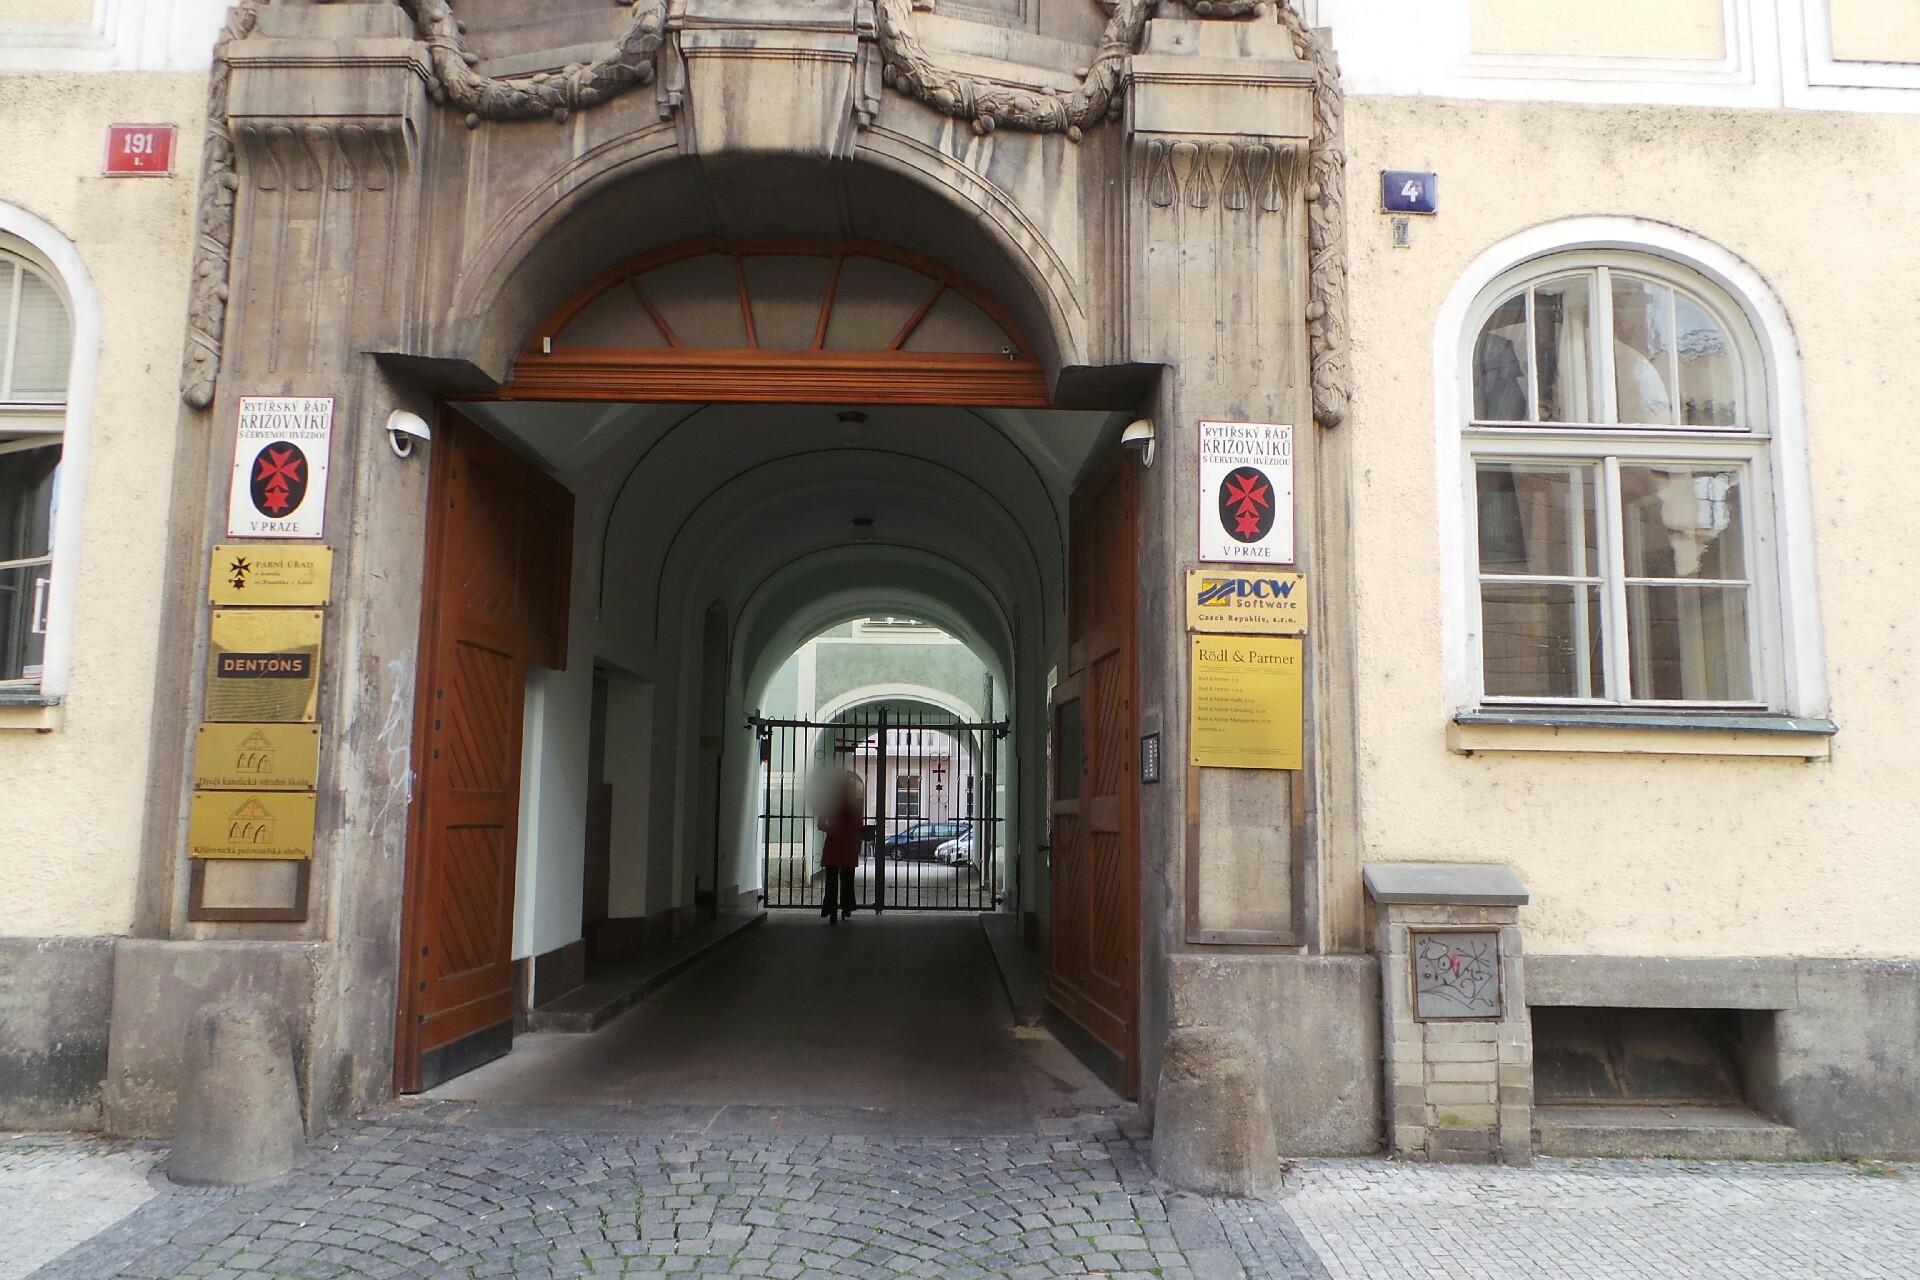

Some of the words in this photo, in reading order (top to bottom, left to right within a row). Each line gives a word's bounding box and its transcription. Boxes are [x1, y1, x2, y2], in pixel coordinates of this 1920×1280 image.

[124, 133, 153, 154] 191
[1401, 180, 1418, 202] 4
[304, 401, 328, 412] ŘÁD
[240, 411, 329, 430] KŘIŽOVNÍKŮ
[1205, 426, 1259, 439] RYTÍŘSKÝ
[1265, 427, 1288, 440] ŘÁD
[1203, 438, 1291, 457] KŘIŽOVNÍKŮ
[1203, 455, 1208, 464] S
[1210, 453, 1252, 465] ČERVENOU
[1253, 455, 1291, 466] HVĚZDOU
[250, 521, 258, 531] V
[261, 521, 300, 532] PRAZE
[1223, 546, 1231, 556] V
[1234, 546, 1271, 557] PRAZE
[1236, 579, 1296, 599] DCW
[1236, 599, 1297, 609] Software
[1199, 648, 1228, 662] Rödl
[1232, 650, 1245, 663] &
[1249, 650, 1295, 665] Partner
[223, 659, 308, 672] DENTONS
